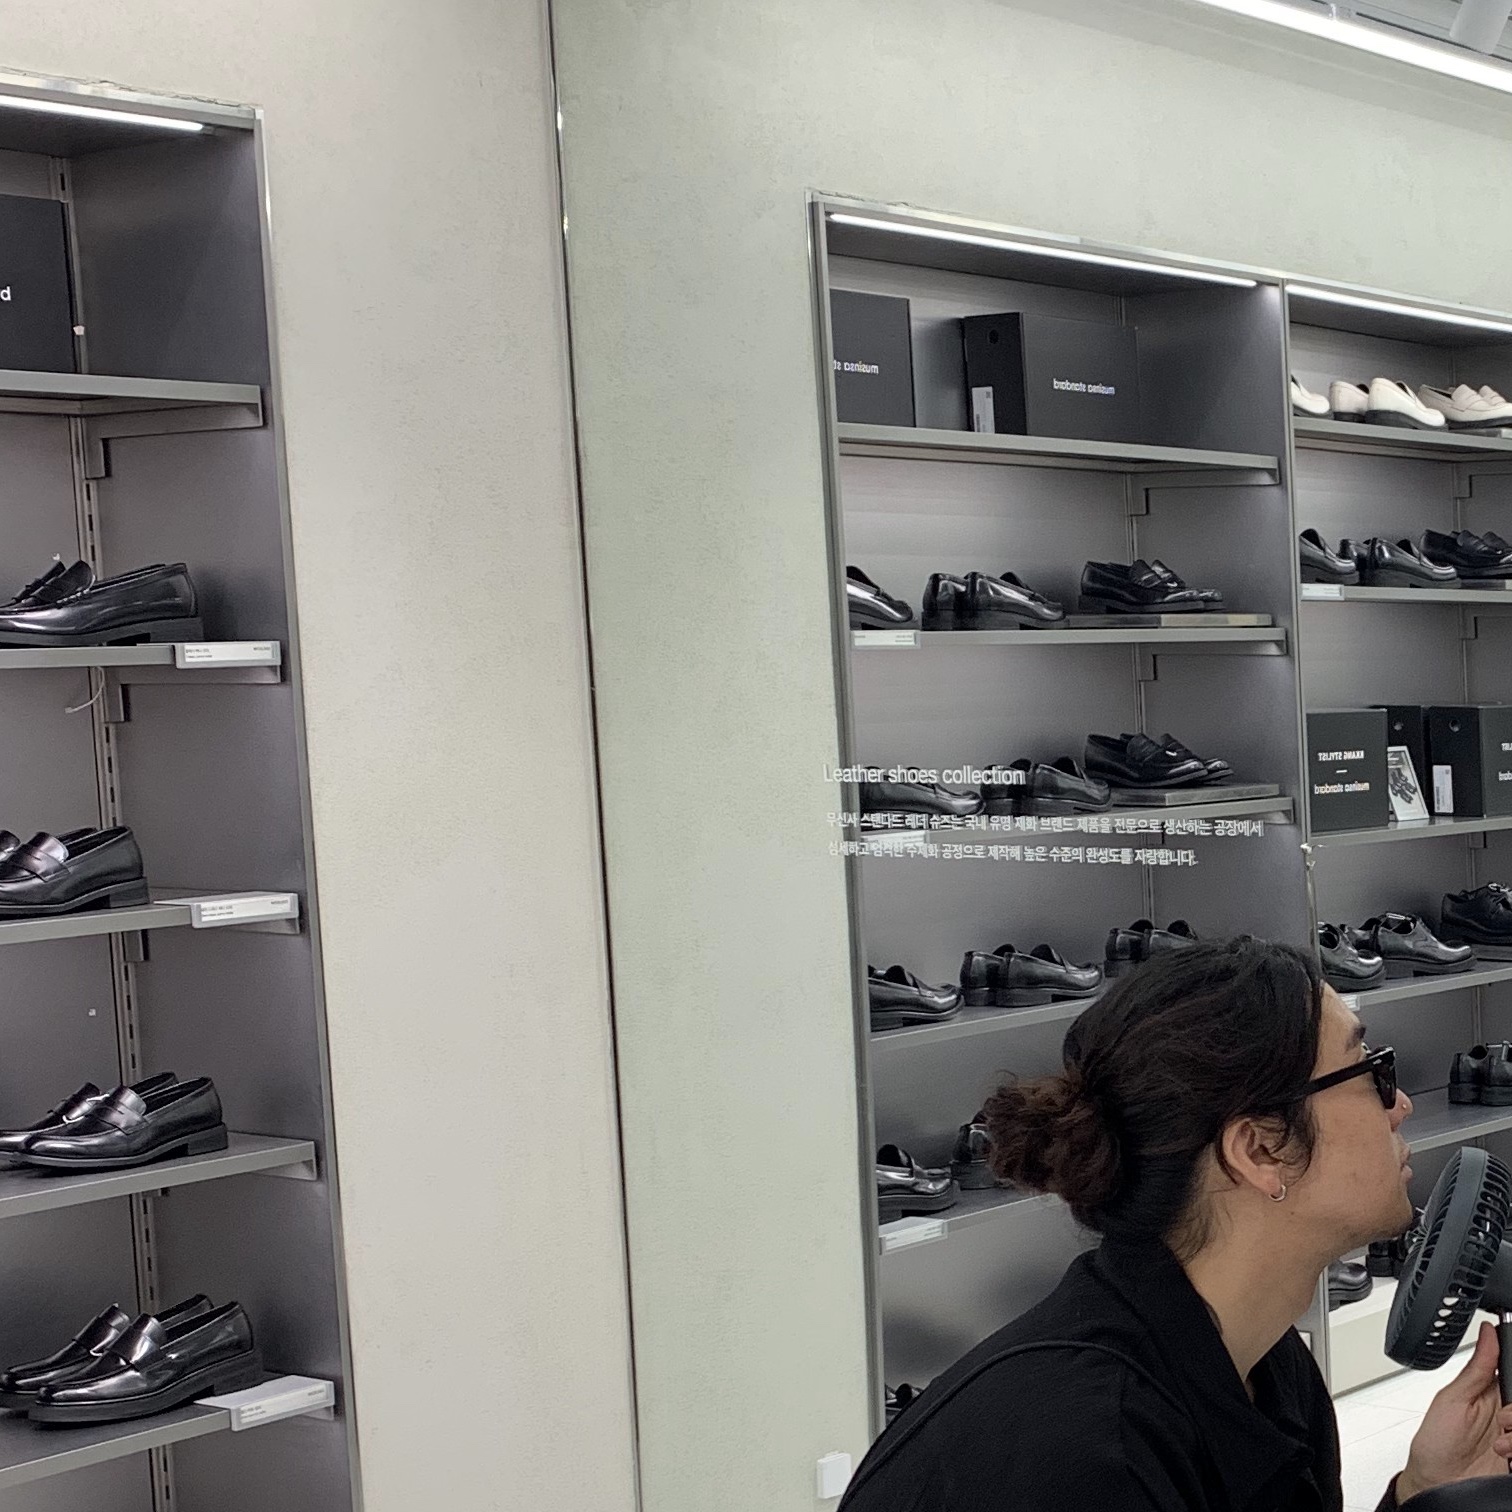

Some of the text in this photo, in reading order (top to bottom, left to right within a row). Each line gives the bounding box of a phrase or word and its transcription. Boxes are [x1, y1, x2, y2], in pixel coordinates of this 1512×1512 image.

[823, 763, 1027, 785] Leather shoes collection
[827, 812, 858, 828] 무신사
[905, 813, 929, 829] 레더
[930, 814, 964, 830] 슈즈는
[965, 814, 989, 831] 국내
[990, 815, 1013, 832] 유명
[1015, 815, 1038, 832] 제화
[1040, 816, 1075, 833] 브랜드
[1077, 816, 1114, 834] 제품을
[1115, 817, 1163, 834] 전문으로
[1164, 819, 1213, 836] 생산하는
[1214, 819, 1265, 837] 공장에서
[942, 843, 986, 860] 공정으로
[987, 845, 1022, 861] 제작해
[1024, 845, 1049, 862] 높은
[1049, 846, 1085, 863] 수준의
[1086, 847, 1134, 865] 완성도를
